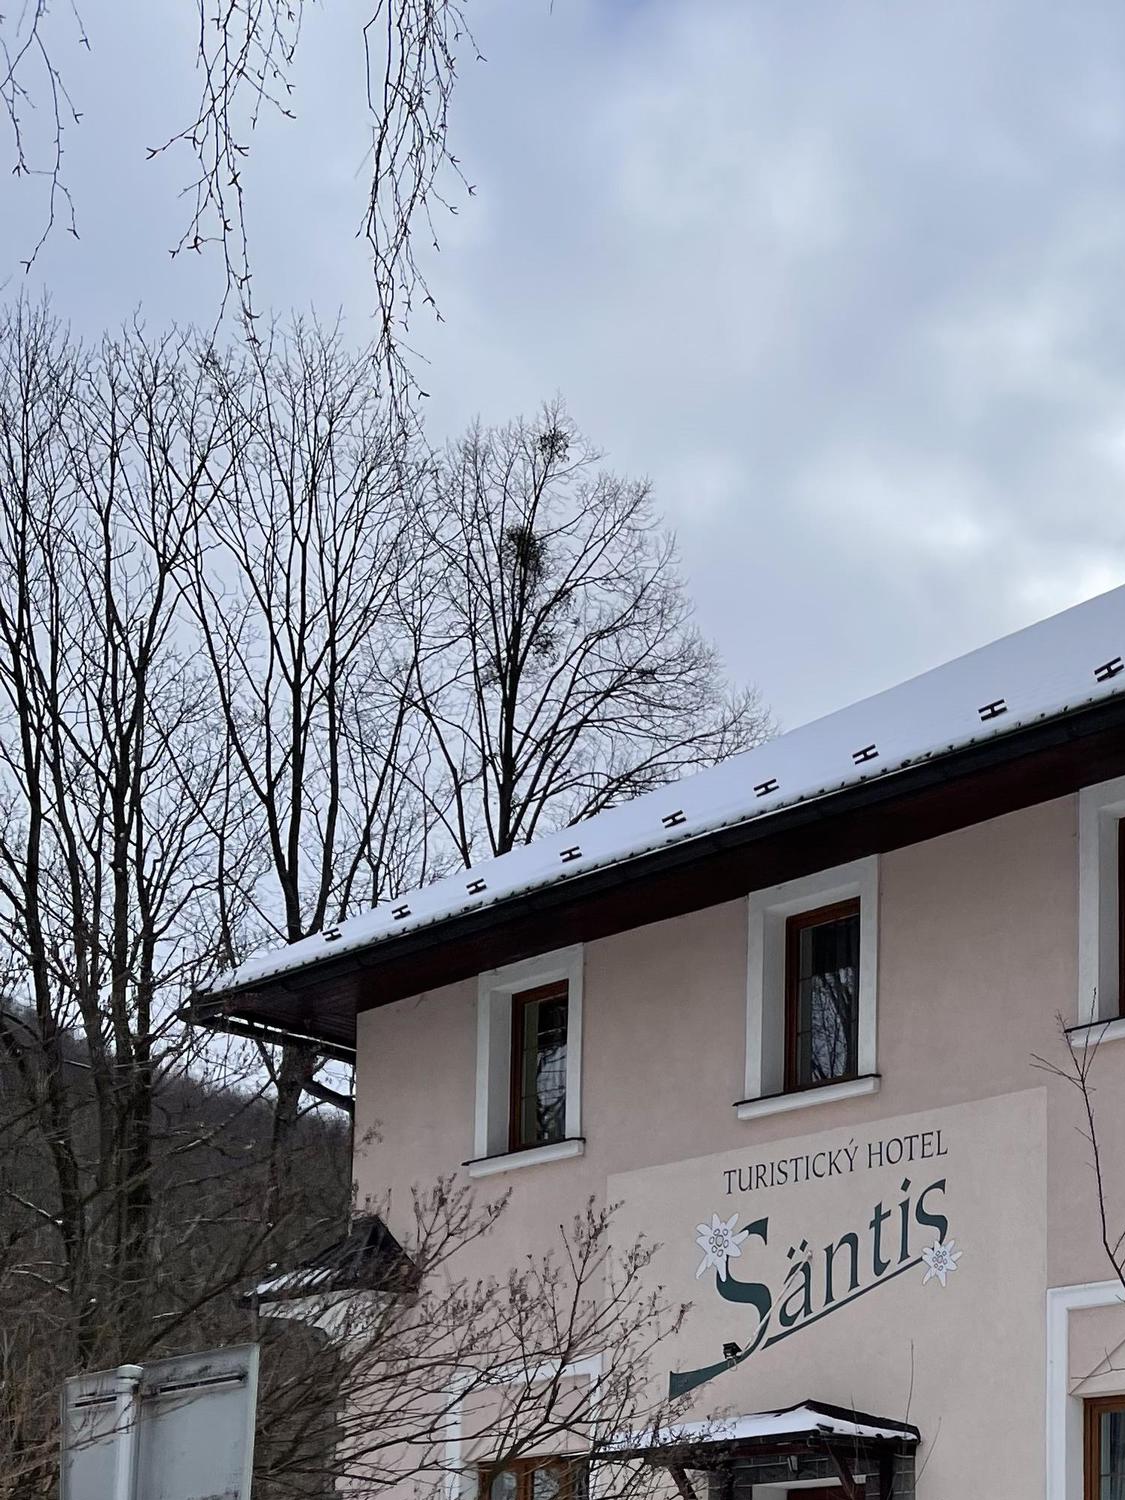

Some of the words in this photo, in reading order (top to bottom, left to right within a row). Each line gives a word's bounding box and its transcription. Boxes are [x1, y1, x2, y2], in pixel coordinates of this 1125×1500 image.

[723, 1138, 859, 1196] TURISTICKÝ
[867, 1129, 949, 1169] HOTEL
[669, 1177, 949, 1400] Säntis
